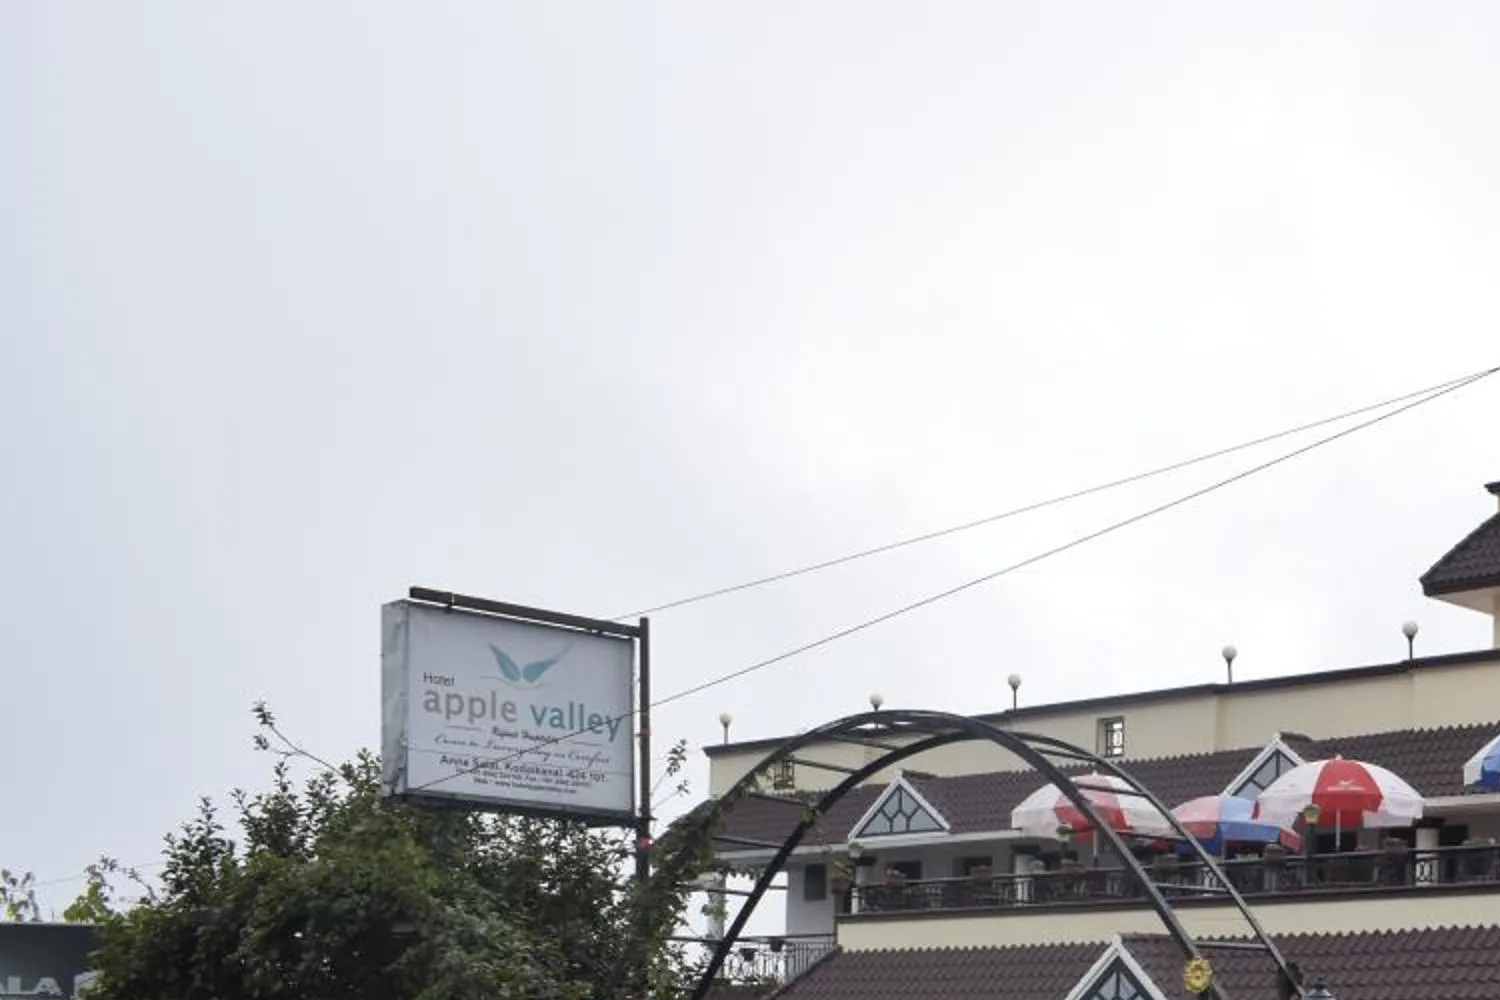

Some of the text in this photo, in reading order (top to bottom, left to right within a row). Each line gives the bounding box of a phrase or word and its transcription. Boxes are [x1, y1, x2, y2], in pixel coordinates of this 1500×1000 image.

[423, 671, 456, 687] Hotel
[423, 689, 519, 724] apple
[529, 701, 621, 742] valley
